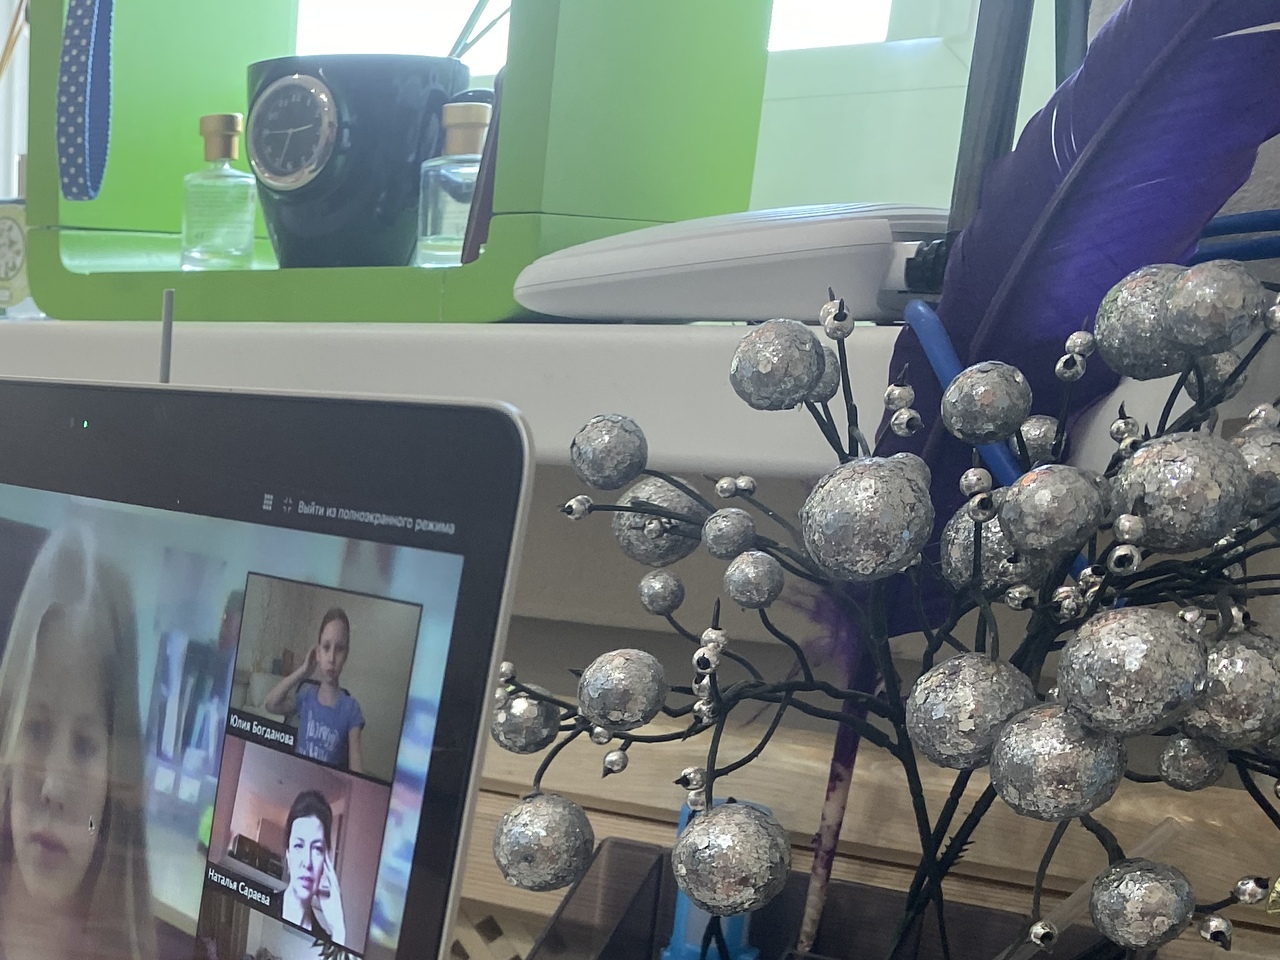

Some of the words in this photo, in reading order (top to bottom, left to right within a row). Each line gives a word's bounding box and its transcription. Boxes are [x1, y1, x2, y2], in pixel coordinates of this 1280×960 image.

[297, 500, 324, 515] Выйти
[326, 507, 337, 518] из
[338, 508, 413, 529] полноэкранного
[414, 518, 456, 535] режима
[230, 714, 251, 731] Юлия
[252, 721, 295, 746] Богданова
[207, 868, 238, 891] Наталья
[239, 882, 271, 906] Сараева
